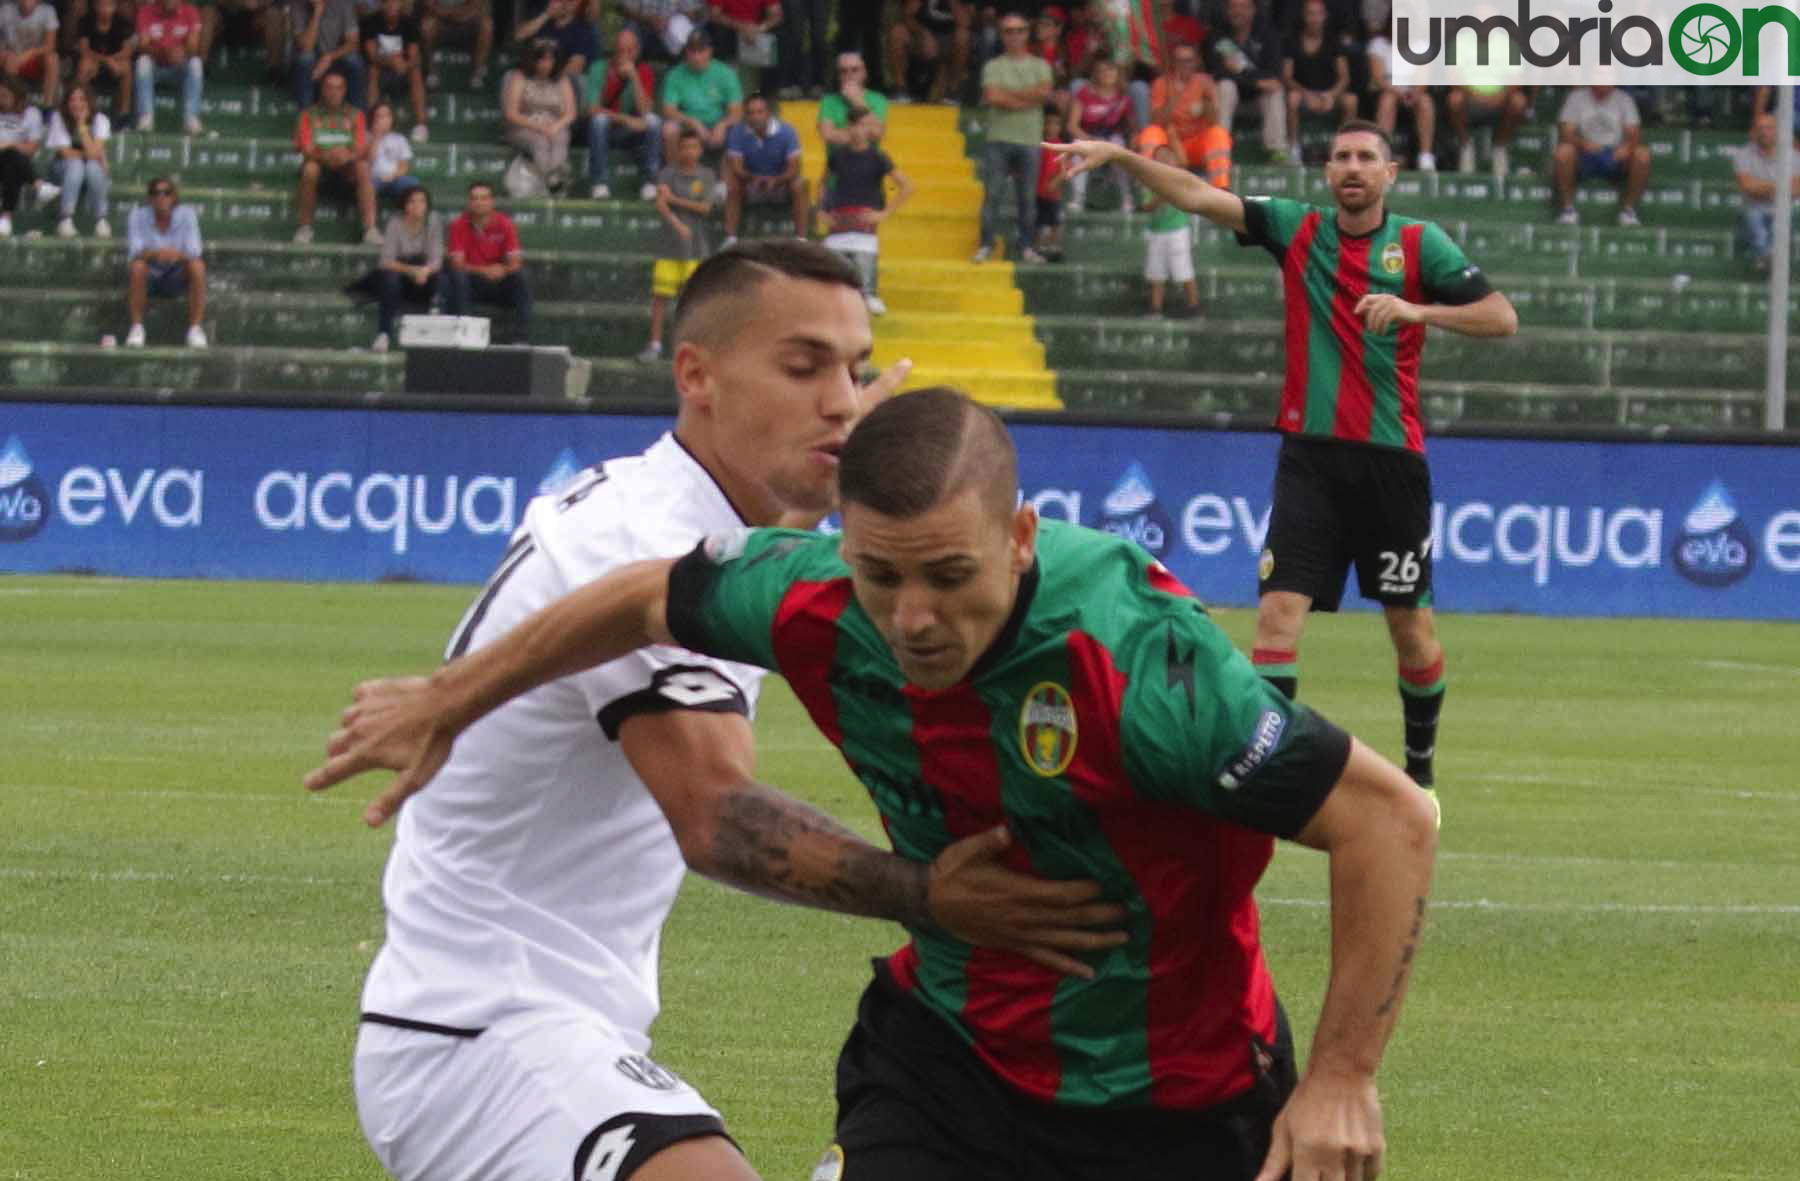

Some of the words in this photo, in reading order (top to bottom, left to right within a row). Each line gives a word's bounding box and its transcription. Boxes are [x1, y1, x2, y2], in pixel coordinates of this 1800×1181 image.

[0, 487, 41, 520] va
[58, 465, 204, 527] eva
[254, 470, 517, 554] acqua
[1180, 493, 1273, 555] ev
[1379, 551, 1421, 583] 26
